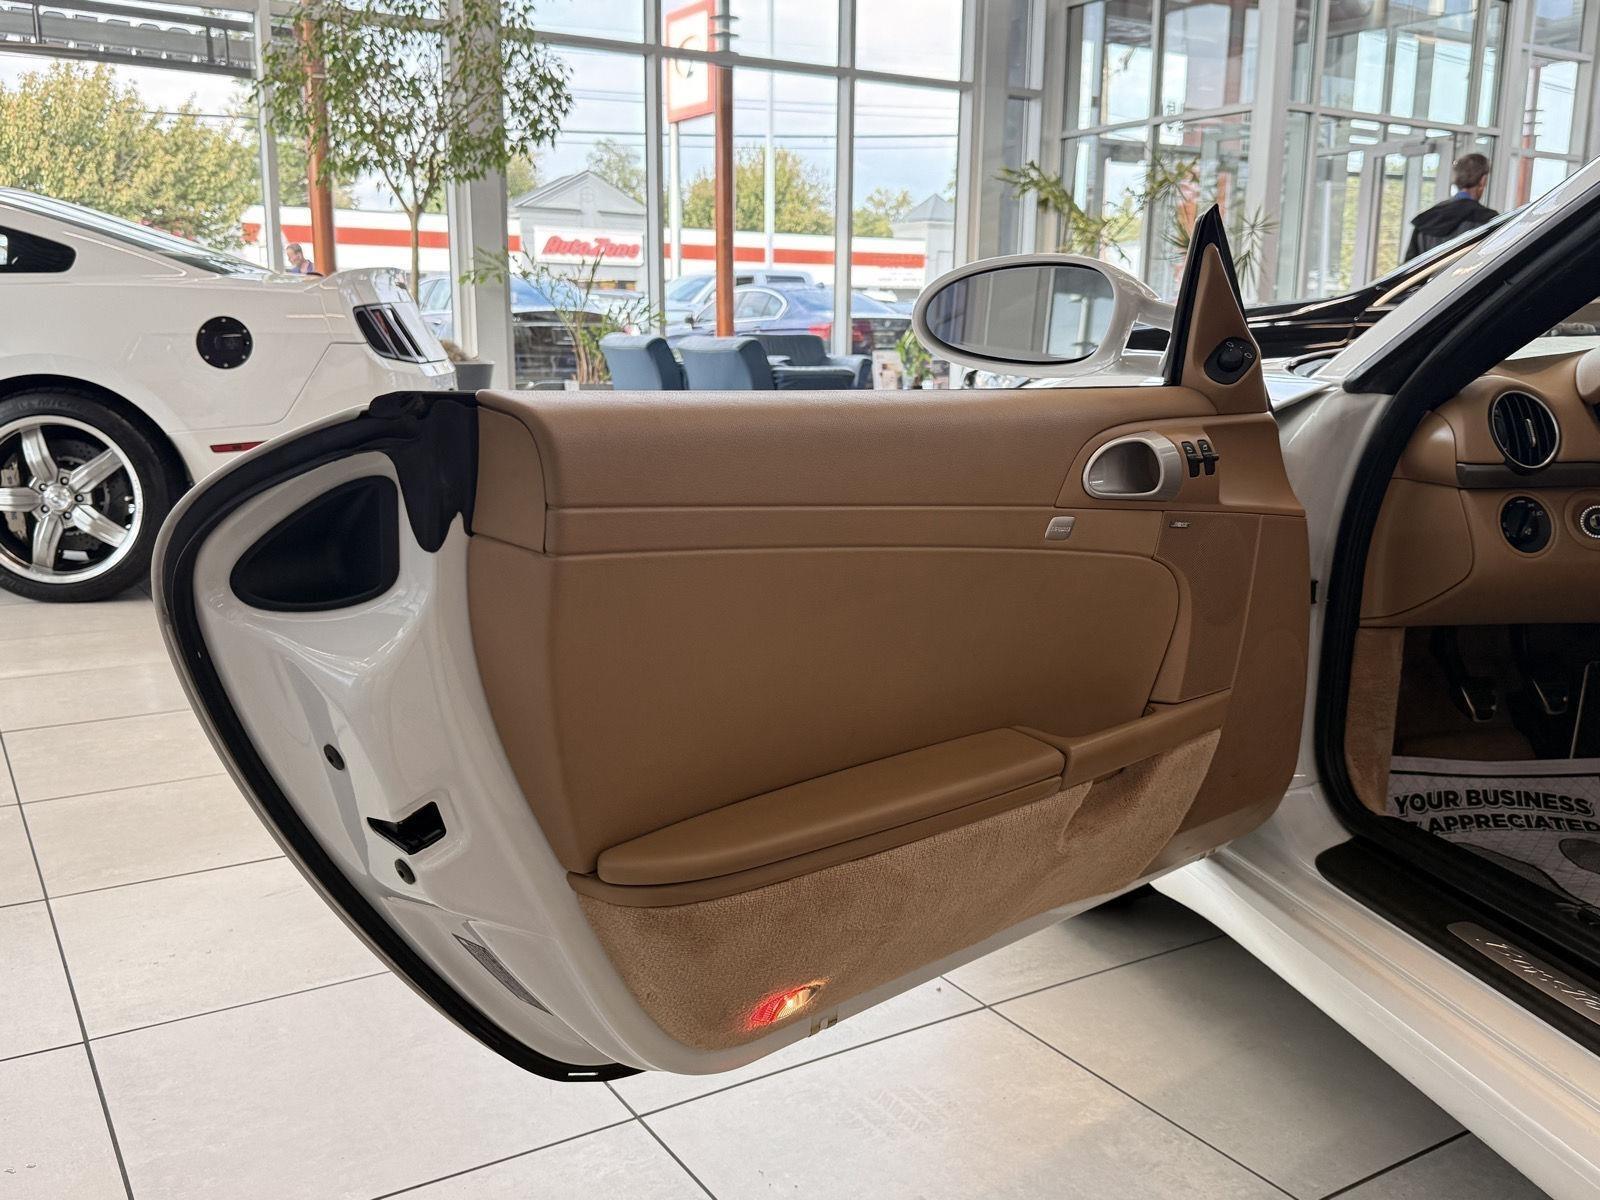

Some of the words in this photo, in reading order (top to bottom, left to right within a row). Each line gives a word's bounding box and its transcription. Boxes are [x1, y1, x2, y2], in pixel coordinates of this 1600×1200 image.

[541, 235, 640, 259] AutoZone
[1394, 789, 1461, 816] YOUR
[1465, 788, 1594, 816] BUSINESS
[1428, 812, 1600, 833] APPRECIATED
